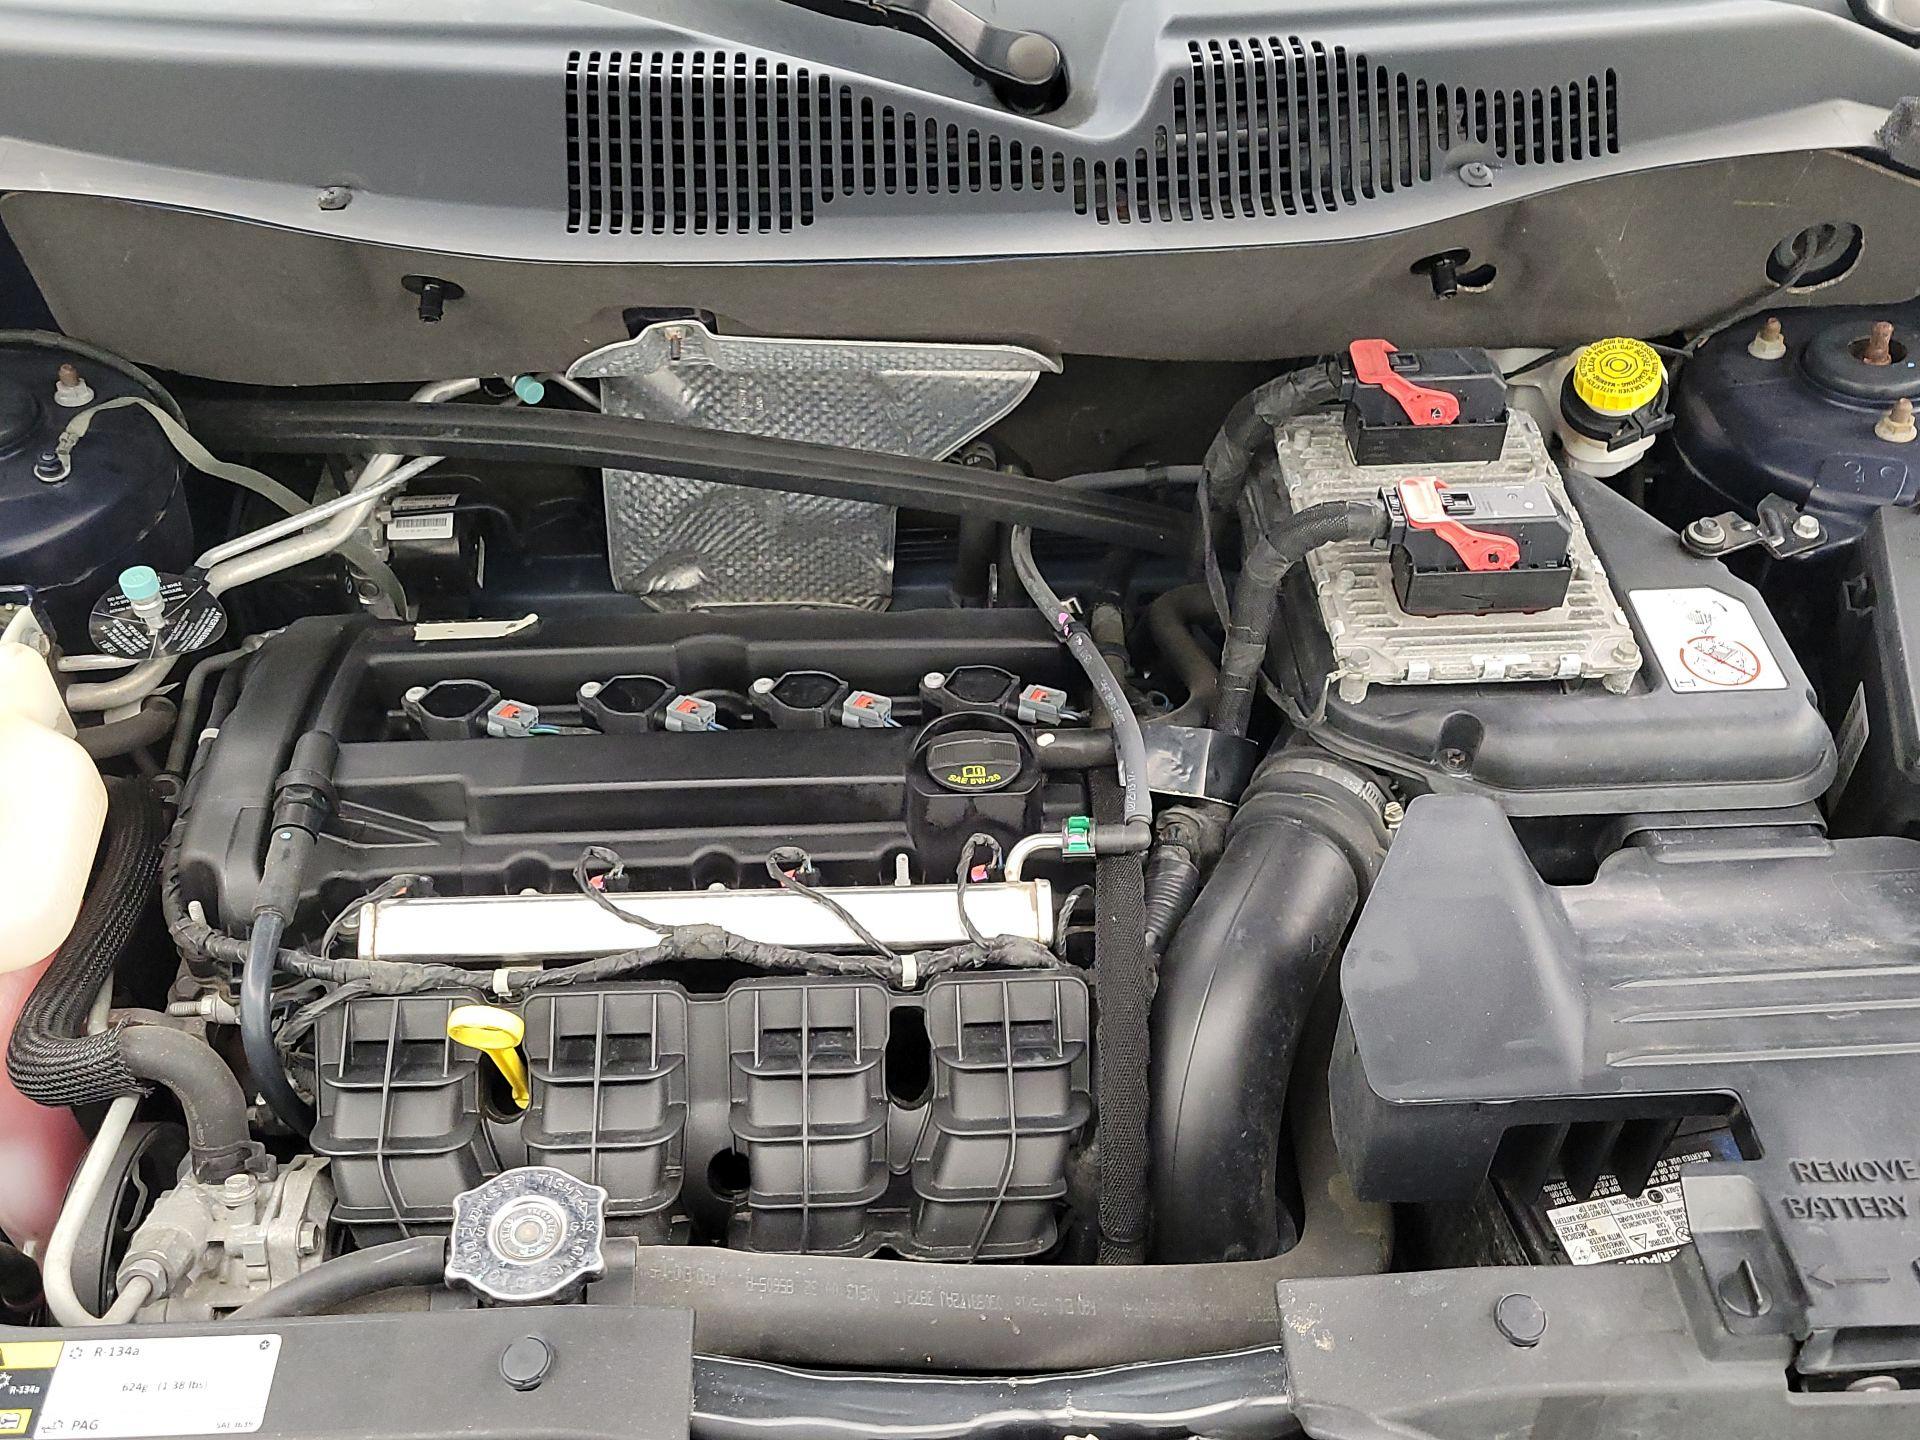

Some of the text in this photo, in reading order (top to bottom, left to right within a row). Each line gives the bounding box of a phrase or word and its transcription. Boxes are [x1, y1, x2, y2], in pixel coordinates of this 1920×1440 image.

[947, 773, 1002, 785] SAE 5W-20
[1788, 1159, 1920, 1182] REMOVE
[479, 1173, 584, 1205] KEEP TIGHT
[1781, 1195, 1910, 1218] BATTERY
[458, 1227, 486, 1237] TVS
[1562, 1231, 1587, 1242] MEDICAL
[1598, 1246, 1630, 1259] FLUSH EYES
[93, 1346, 140, 1357] R-134a
[9, 1385, 40, 1395] R-134a
[71, 1420, 100, 1431] PAG
